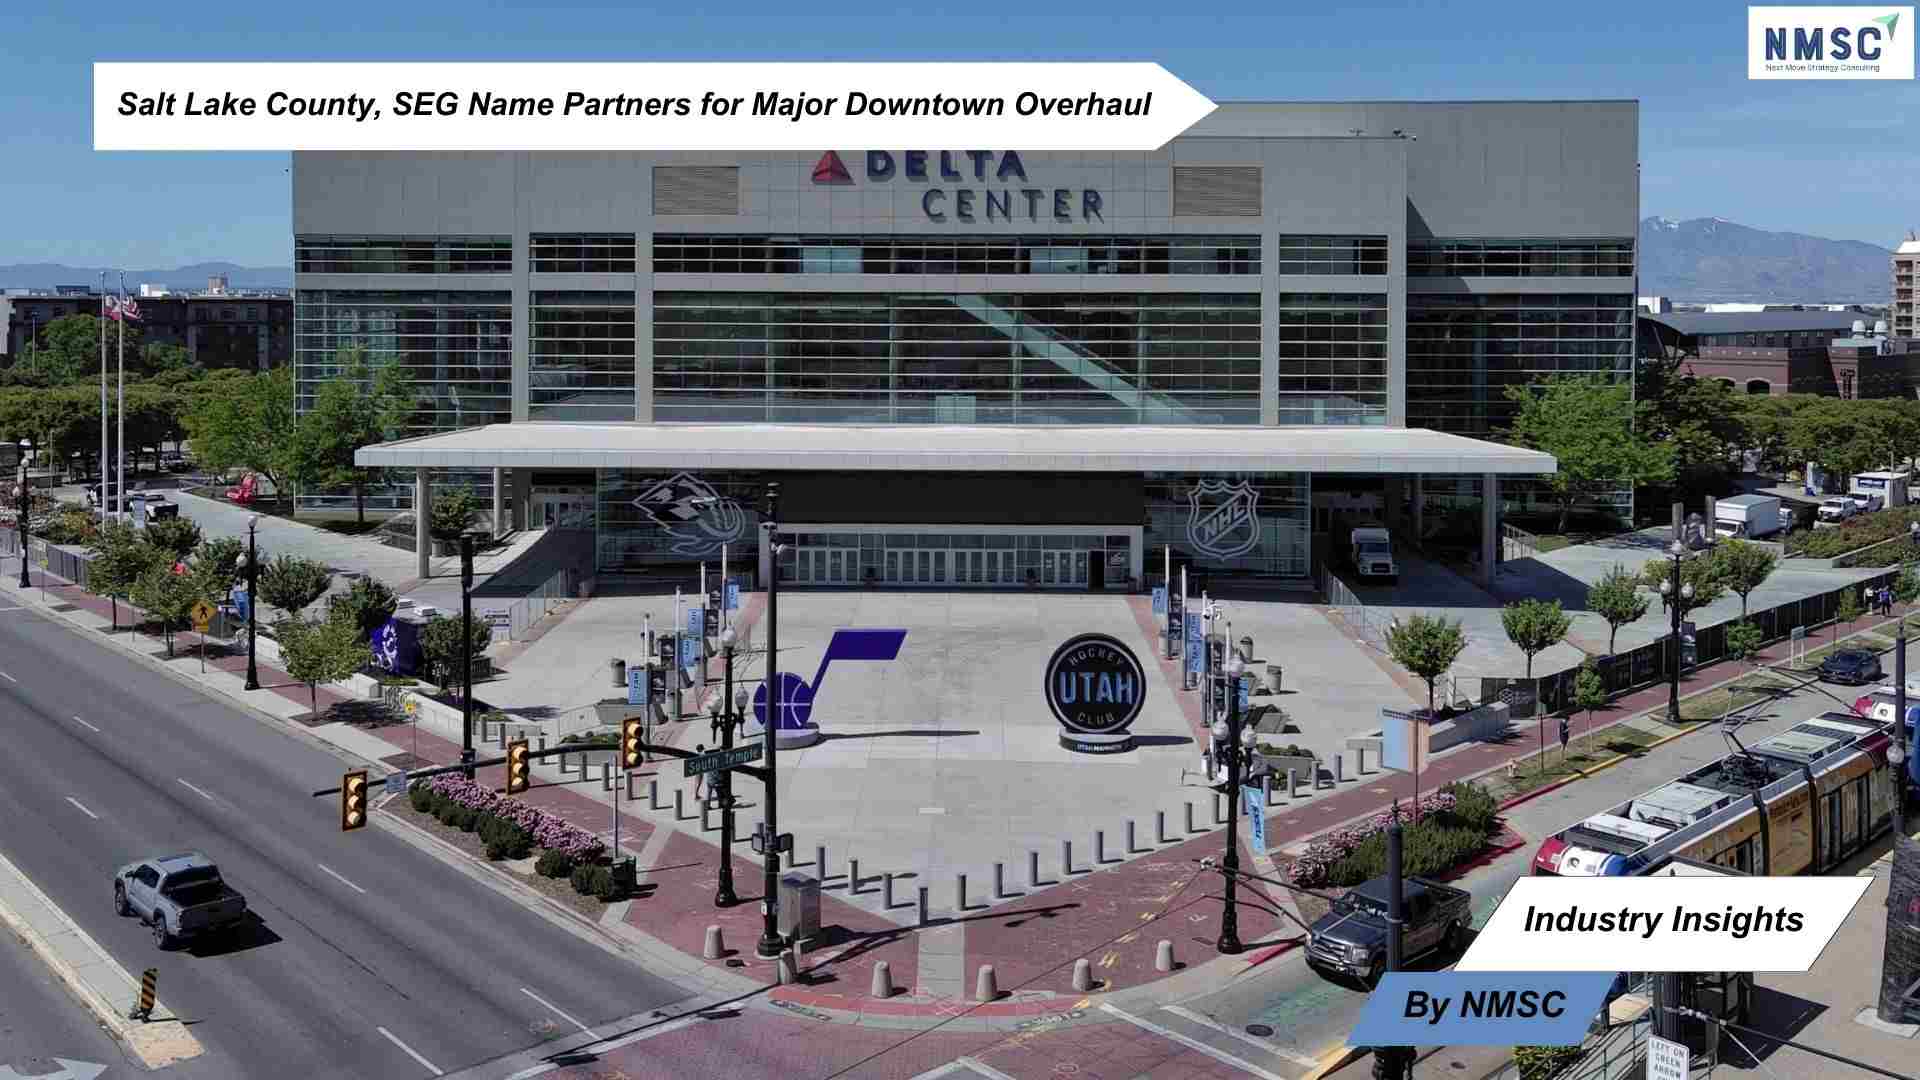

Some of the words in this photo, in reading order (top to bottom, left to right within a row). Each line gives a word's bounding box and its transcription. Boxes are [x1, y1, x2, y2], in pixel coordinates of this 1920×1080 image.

[866, 150, 1026, 180] DELTA
[922, 189, 1103, 222] CENTER
[1203, 500, 1246, 543] NHL
[1068, 647, 1124, 665] HOCKEY
[1059, 671, 1132, 704] UTAH
[1079, 711, 1115, 725] CLUB
[687, 756, 719, 774] South
[1673, 1047, 1686, 1058] ON
